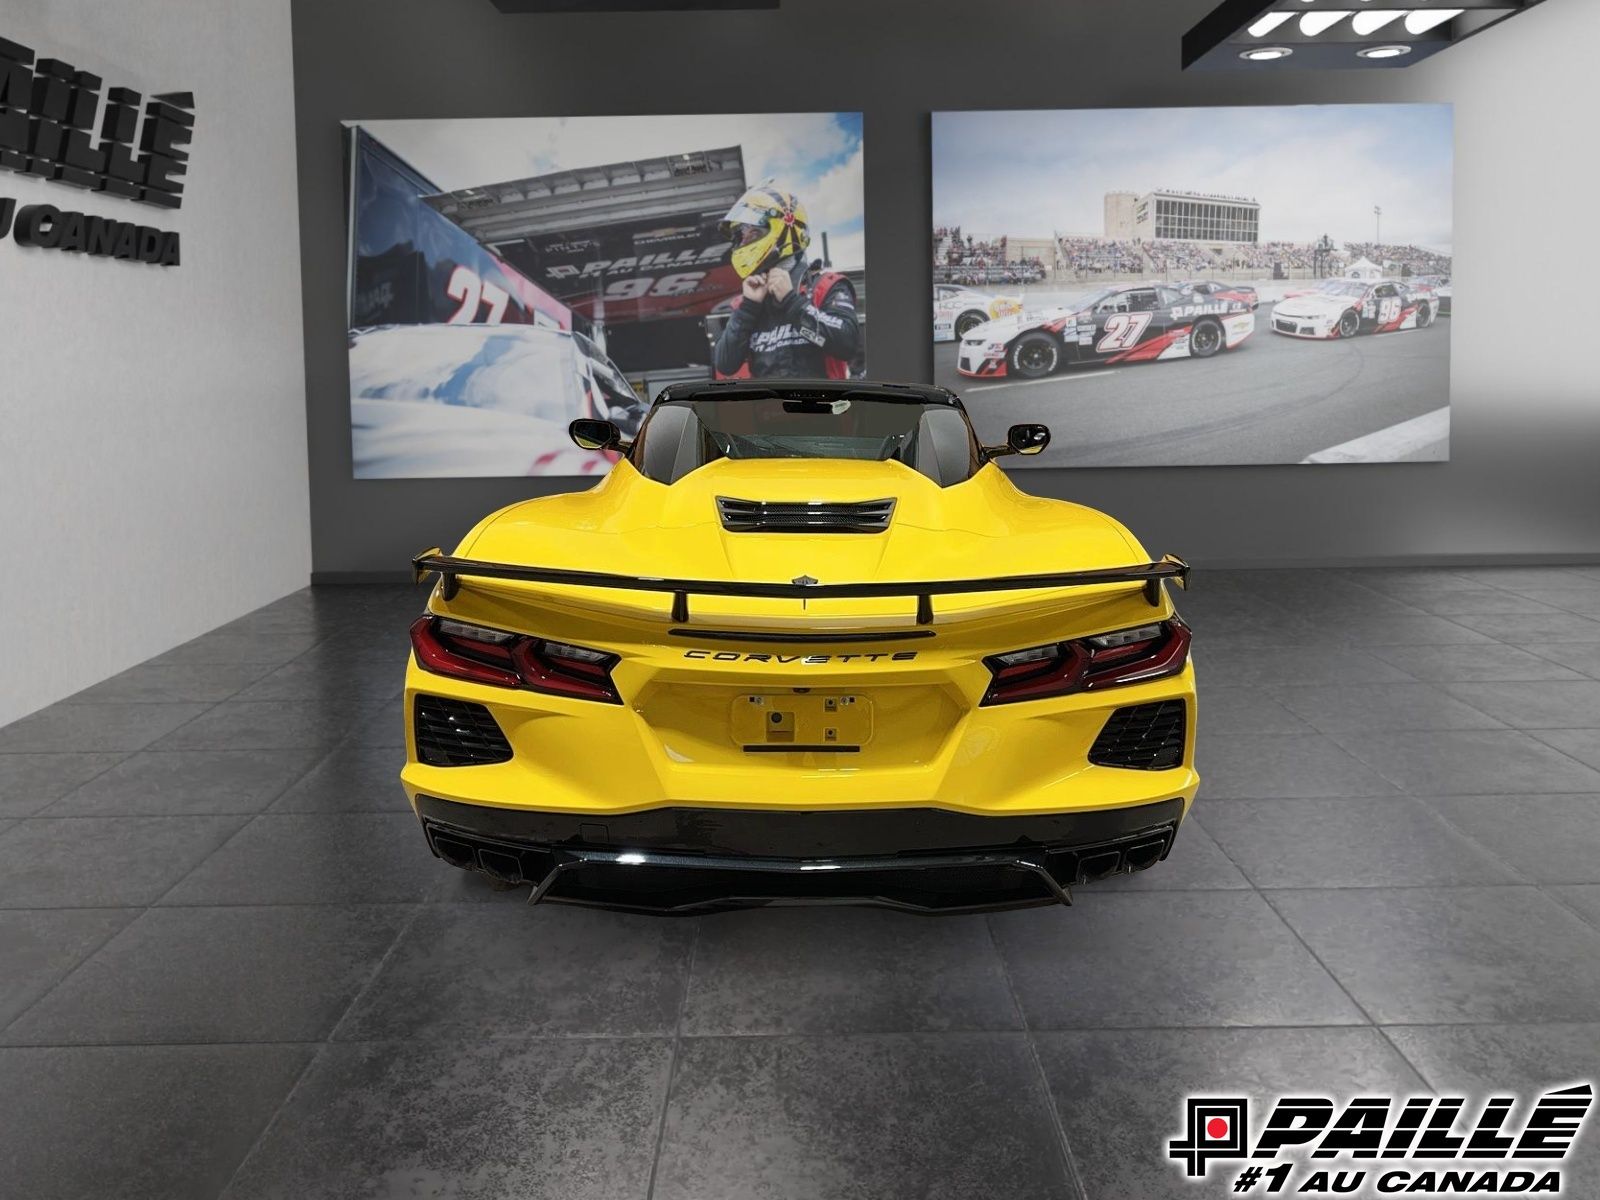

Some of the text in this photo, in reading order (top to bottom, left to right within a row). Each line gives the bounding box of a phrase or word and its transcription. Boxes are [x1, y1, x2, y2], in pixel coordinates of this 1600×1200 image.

[14, 203, 181, 266] CANADA
[447, 264, 509, 325] 27
[604, 271, 707, 302] 96
[1095, 311, 1151, 354] 27
[683, 649, 919, 665] CORVETTE
